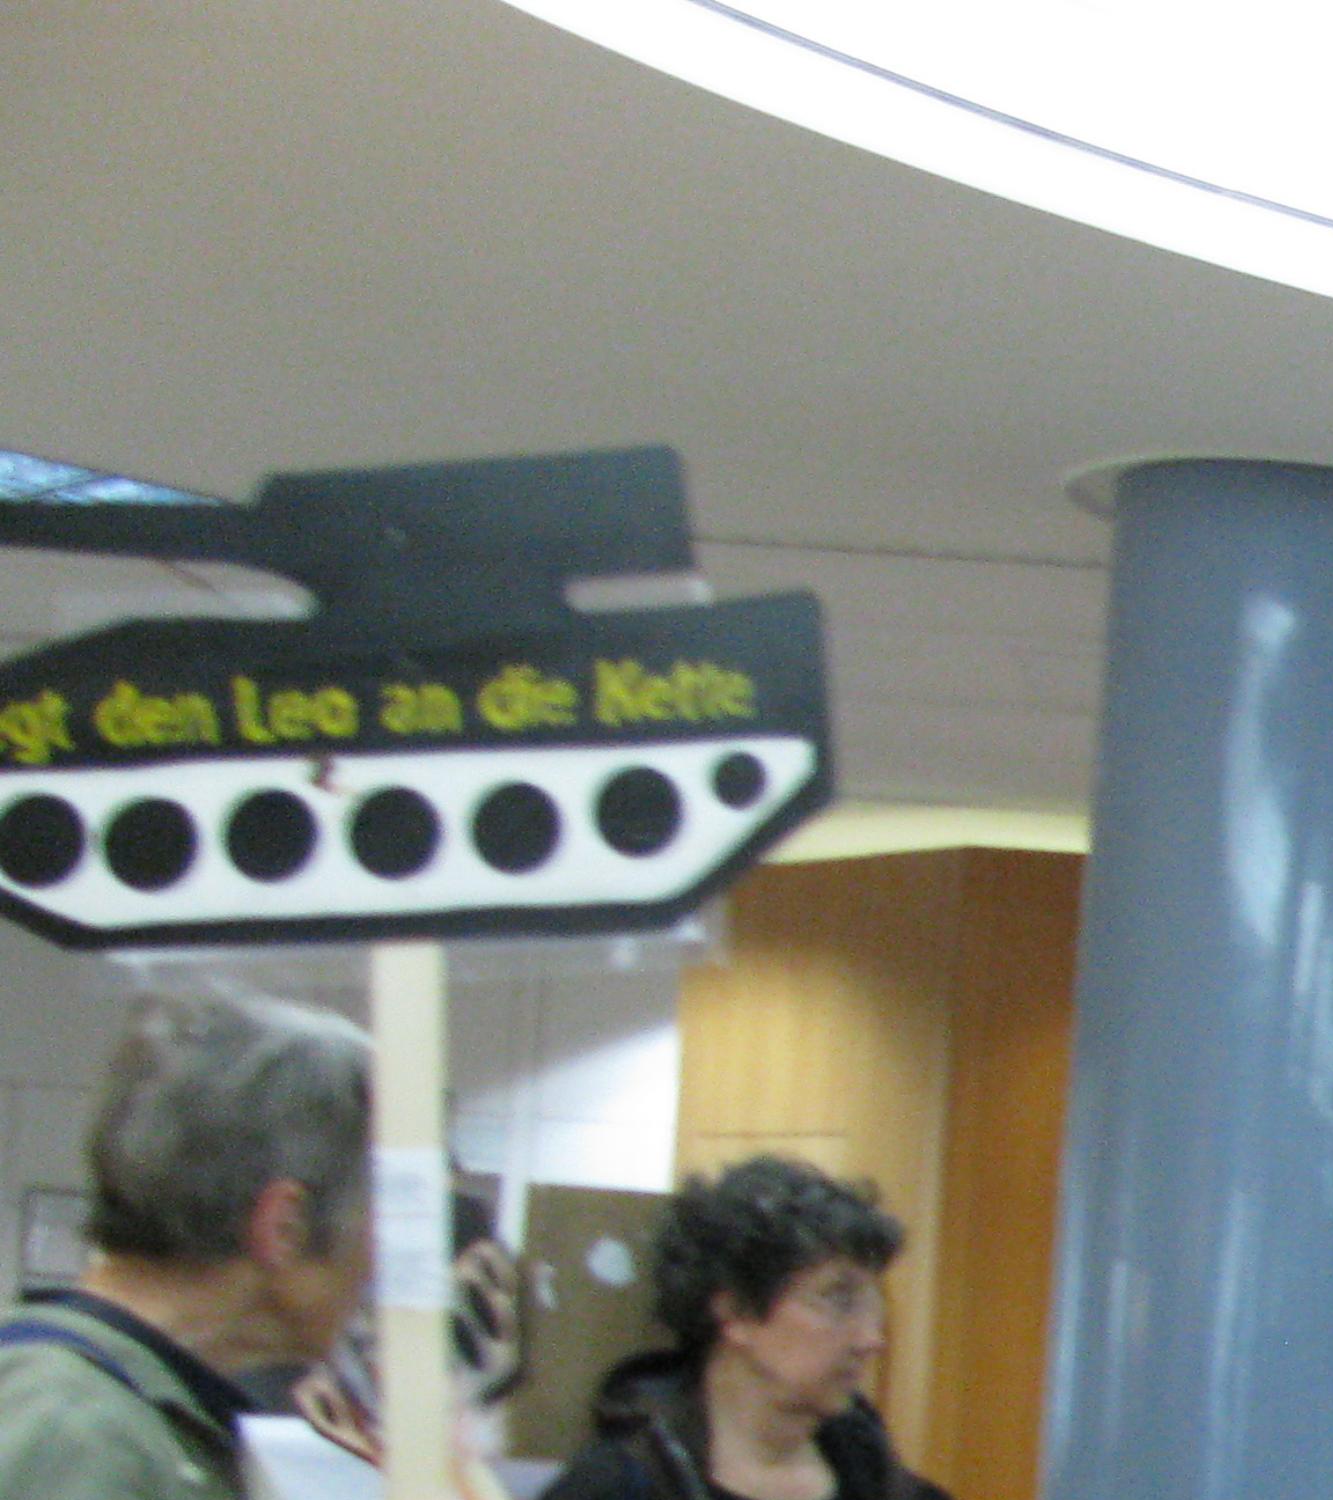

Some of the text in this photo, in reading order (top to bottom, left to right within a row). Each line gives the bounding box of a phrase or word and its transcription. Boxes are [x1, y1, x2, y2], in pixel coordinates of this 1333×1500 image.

[95, 679, 222, 747] den
[232, 675, 357, 743] Leo
[380, 682, 463, 735] an
[477, 664, 578, 731] die
[596, 659, 757, 727] Kette
